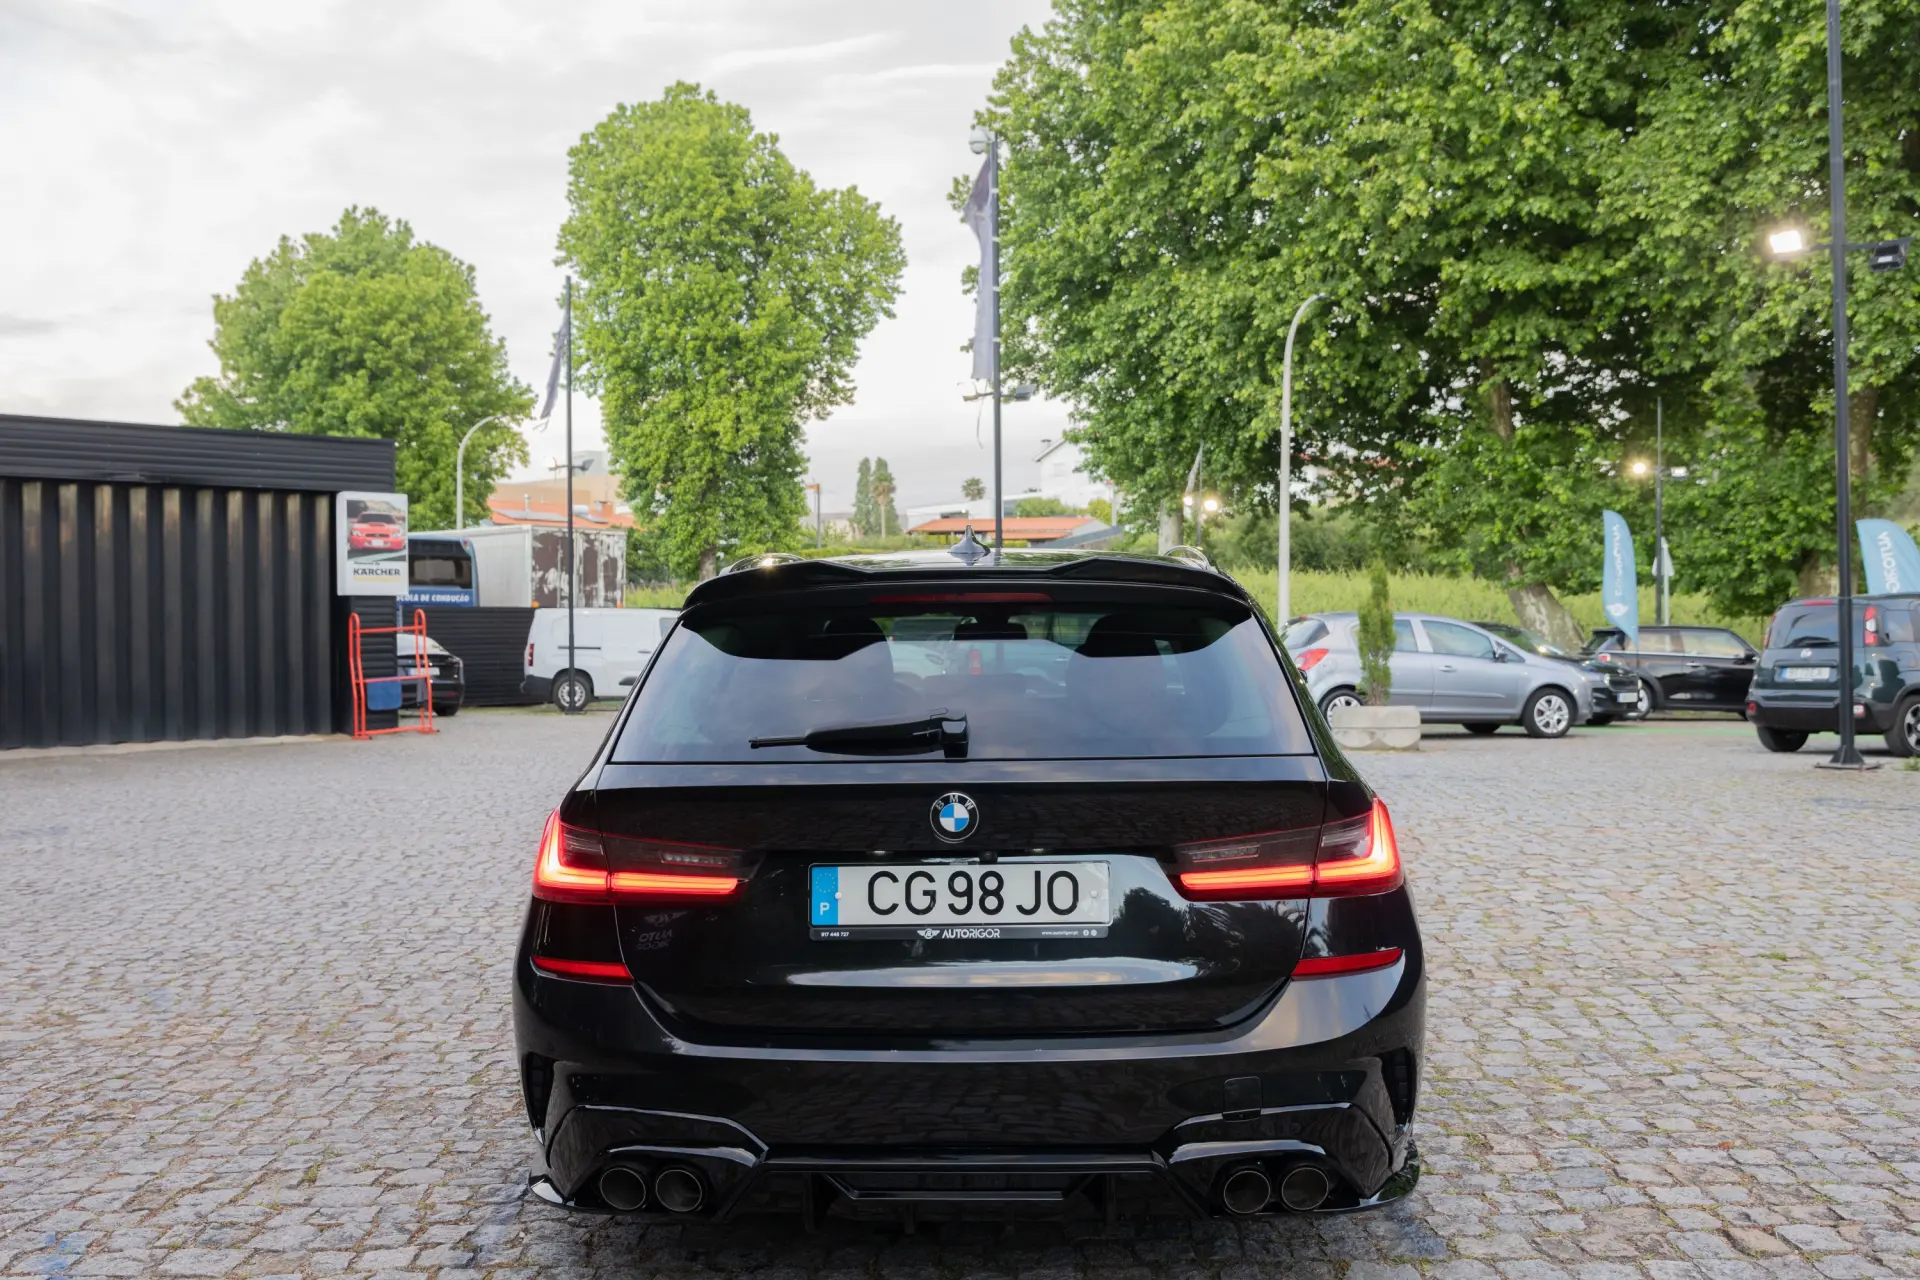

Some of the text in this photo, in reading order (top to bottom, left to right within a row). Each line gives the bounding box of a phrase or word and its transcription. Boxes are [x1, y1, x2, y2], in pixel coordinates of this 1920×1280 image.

[420, 594, 430, 602] DE
[934, 794, 975, 811] BMW
[867, 870, 1080, 916] CG 98 JO
[819, 902, 830, 916] P
[941, 928, 1000, 938] AUTORIGOR
